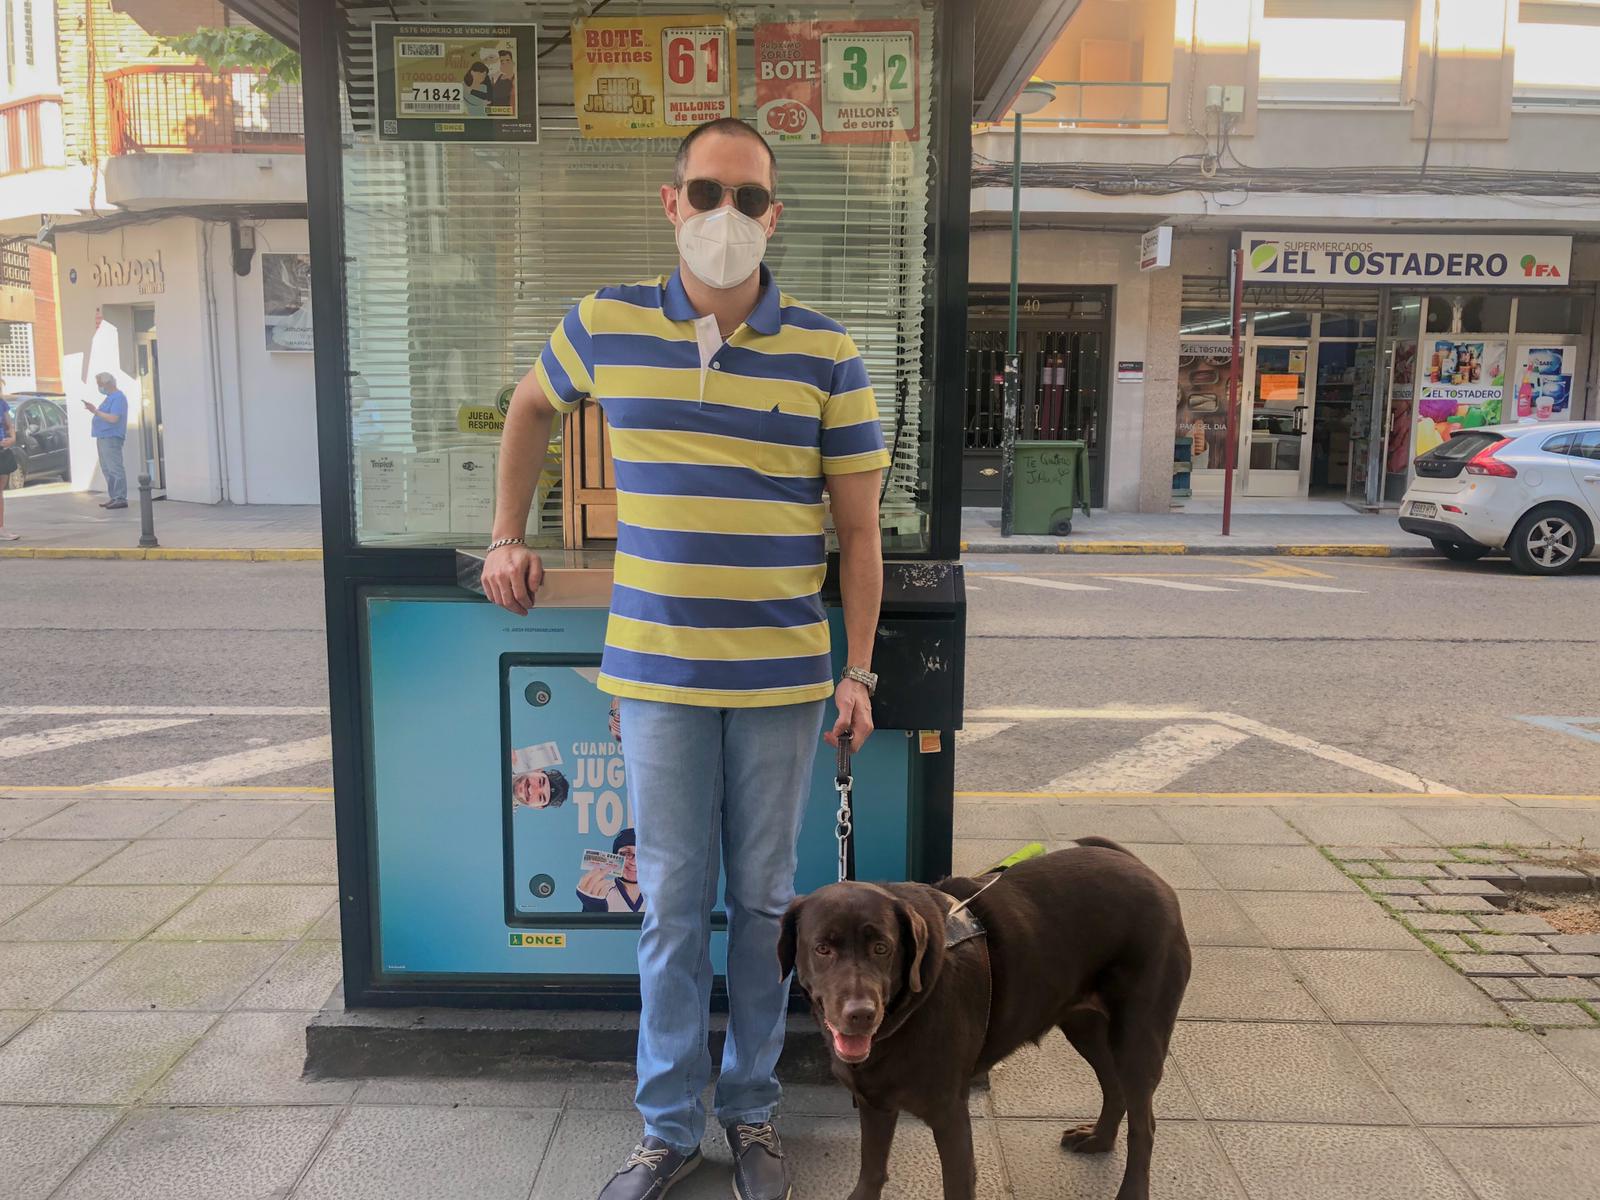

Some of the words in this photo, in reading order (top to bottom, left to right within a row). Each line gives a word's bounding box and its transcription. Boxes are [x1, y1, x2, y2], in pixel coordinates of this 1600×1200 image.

[399, 26, 418, 34] ESTE
[454, 26, 463, 34] SE
[465, 26, 490, 35] VENDE
[585, 29, 644, 49] BOTE
[586, 50, 653, 64] viernes
[667, 37, 720, 85] 61
[760, 50, 801, 60] SORTEO
[760, 60, 817, 80] BOTE
[597, 77, 641, 96] EURO
[412, 88, 461, 101] 71842
[584, 94, 655, 114] JACKPOT
[669, 101, 725, 112] MILLONES
[674, 112, 689, 122] de
[691, 113, 721, 121] euros
[837, 107, 900, 119] MILLONES
[842, 119, 857, 130] de
[861, 119, 895, 129] euros
[1284, 241, 1373, 253] SUPERMERCADOS
[1283, 251, 1315, 274] EL
[1325, 251, 1508, 277] TOSTADERO
[1023, 299, 1041, 312] 40
[1432, 389, 1444, 398] EL
[1445, 389, 1502, 399] TOSTADERO
[468, 411, 494, 421] JUEGA
[525, 935, 563, 945] ONCE
